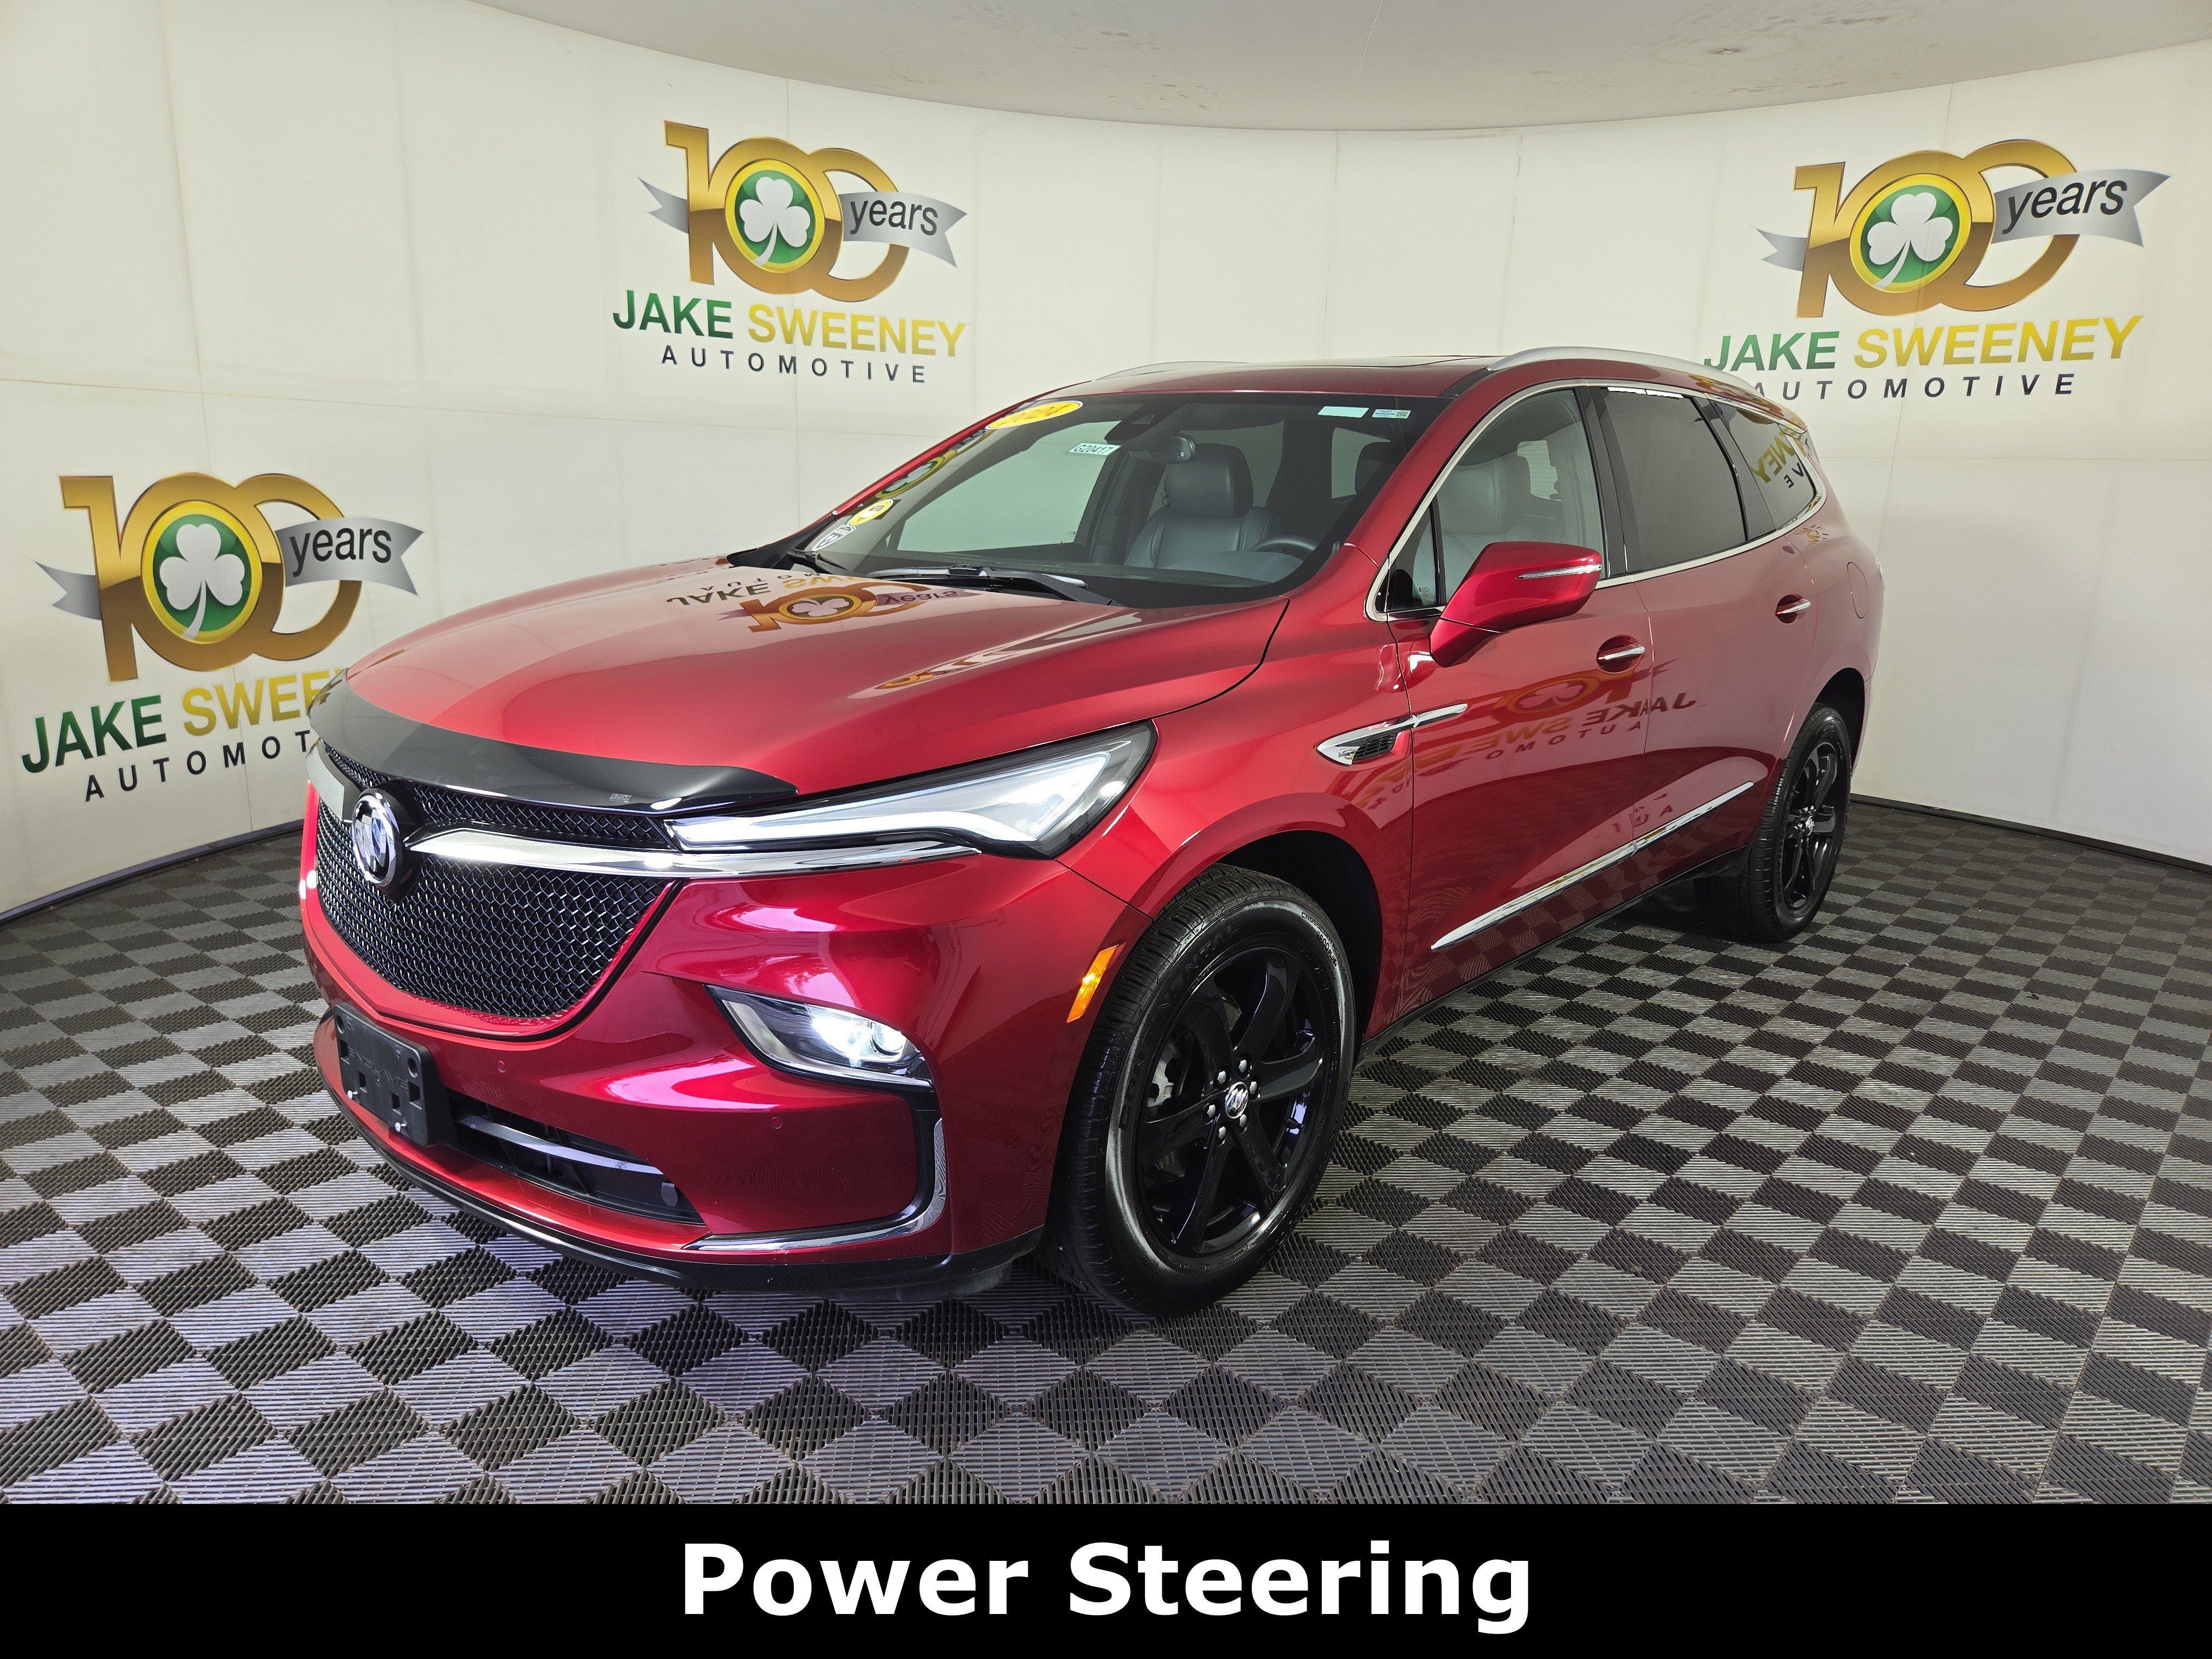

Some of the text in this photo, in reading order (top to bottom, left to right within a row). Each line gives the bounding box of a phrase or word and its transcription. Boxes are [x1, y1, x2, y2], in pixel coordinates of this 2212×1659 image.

[664, 119, 939, 303] 100 years
[1793, 138, 2129, 319] 100 years
[613, 290, 967, 357] JAKE SWEENEY
[1703, 315, 2144, 371] JAKE SWEENEY
[661, 345, 925, 383] AUTOMOTIVE
[1073, 445, 1114, 454] G20417
[59, 472, 392, 682] 100 years
[22, 668, 343, 774] JAKE SWEE
[86, 729, 311, 802] AUTOMOT
